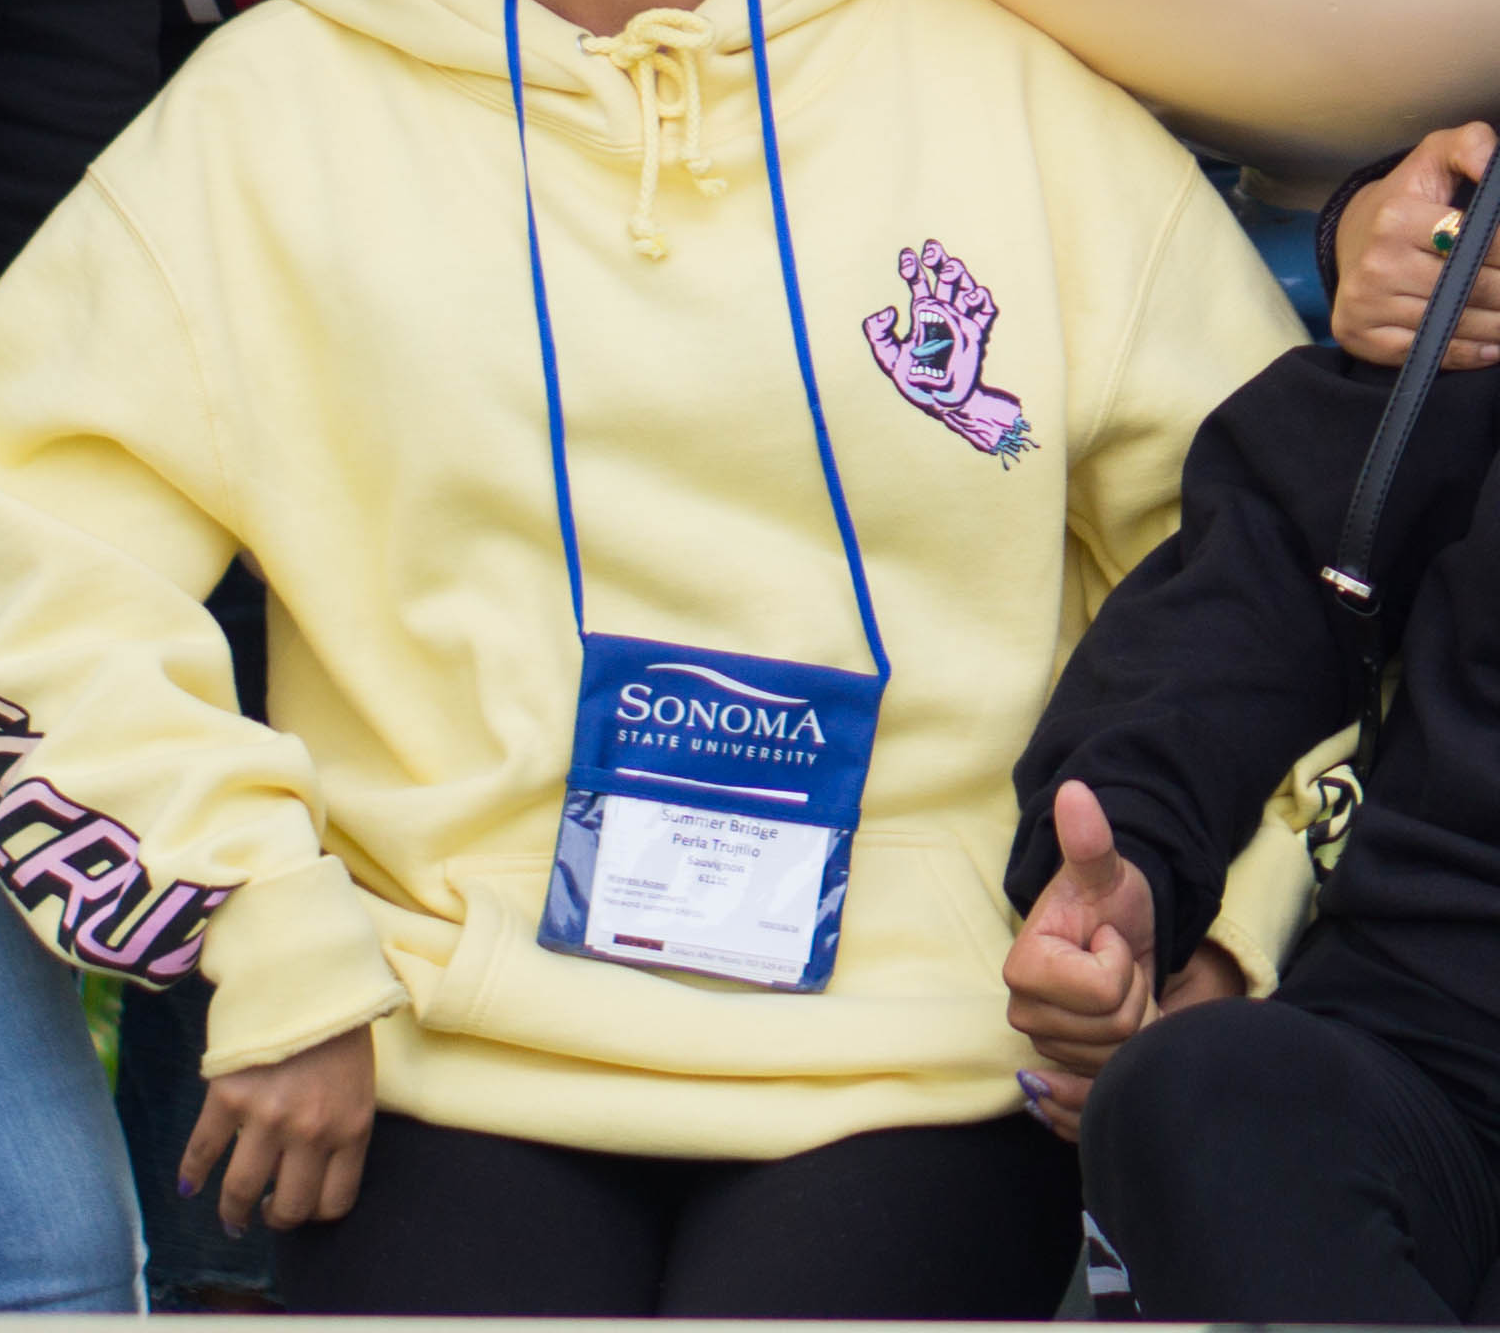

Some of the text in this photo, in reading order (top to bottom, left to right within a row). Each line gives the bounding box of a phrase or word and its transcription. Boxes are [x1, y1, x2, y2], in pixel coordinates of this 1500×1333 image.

[616, 684, 826, 744] SONOMA
[618, 729, 819, 767] STATE UNIVERSITY
[662, 809, 778, 840] Summer Bridge
